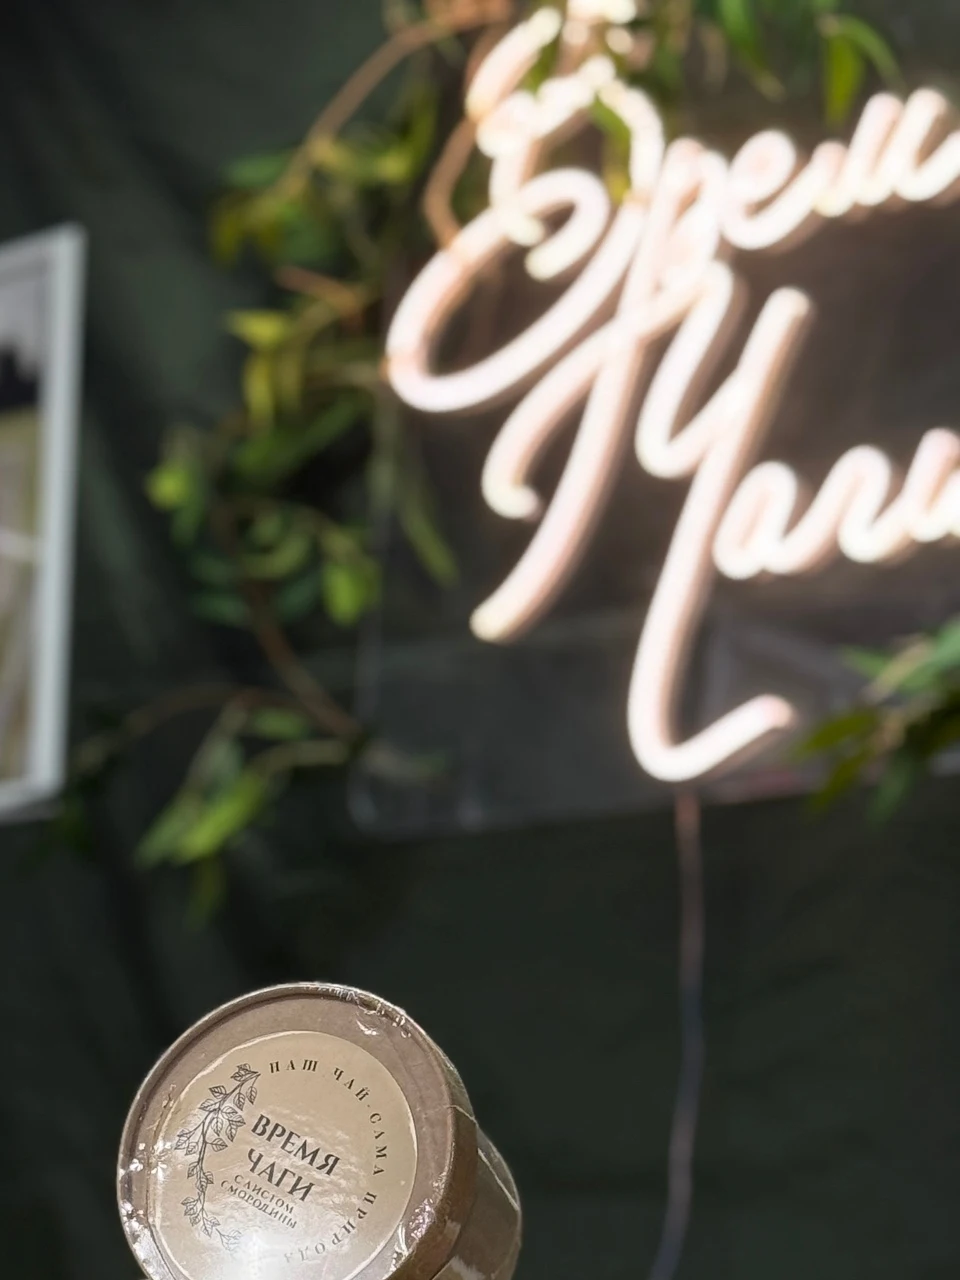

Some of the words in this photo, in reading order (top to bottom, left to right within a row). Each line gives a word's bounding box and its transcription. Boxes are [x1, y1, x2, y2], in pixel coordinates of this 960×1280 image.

[250, 1113, 341, 1176] ВРЕМЯ
[247, 1147, 316, 1202] ЧАГИ
[220, 1179, 298, 1229] СМОРОДИНЫ
